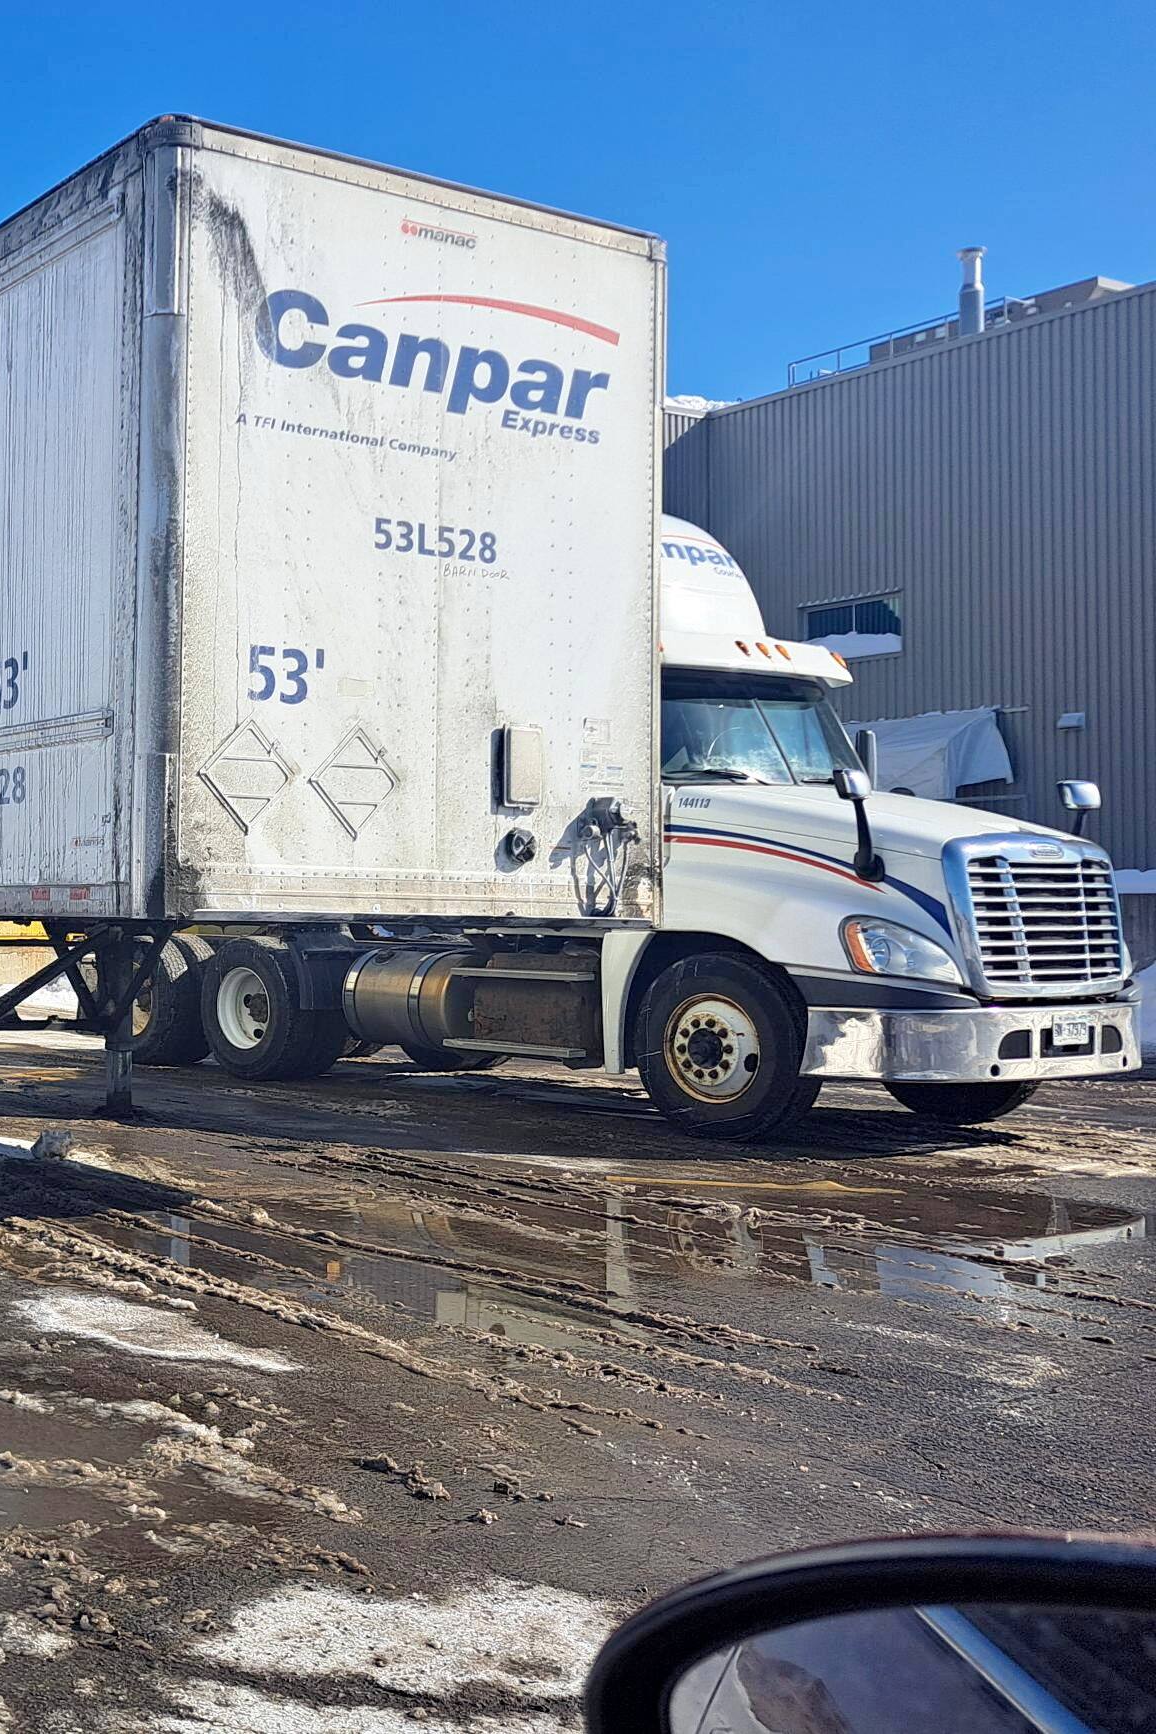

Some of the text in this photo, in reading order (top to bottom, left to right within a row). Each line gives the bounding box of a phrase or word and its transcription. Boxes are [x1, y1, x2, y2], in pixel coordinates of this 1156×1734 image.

[418, 227, 477, 249] manac
[255, 289, 610, 420] Canpar
[236, 412, 458, 463] A TFI International Company
[501, 409, 601, 446] Express
[374, 518, 497, 565] 53L528
[660, 542, 735, 568] npar
[247, 645, 326, 704] 53'
